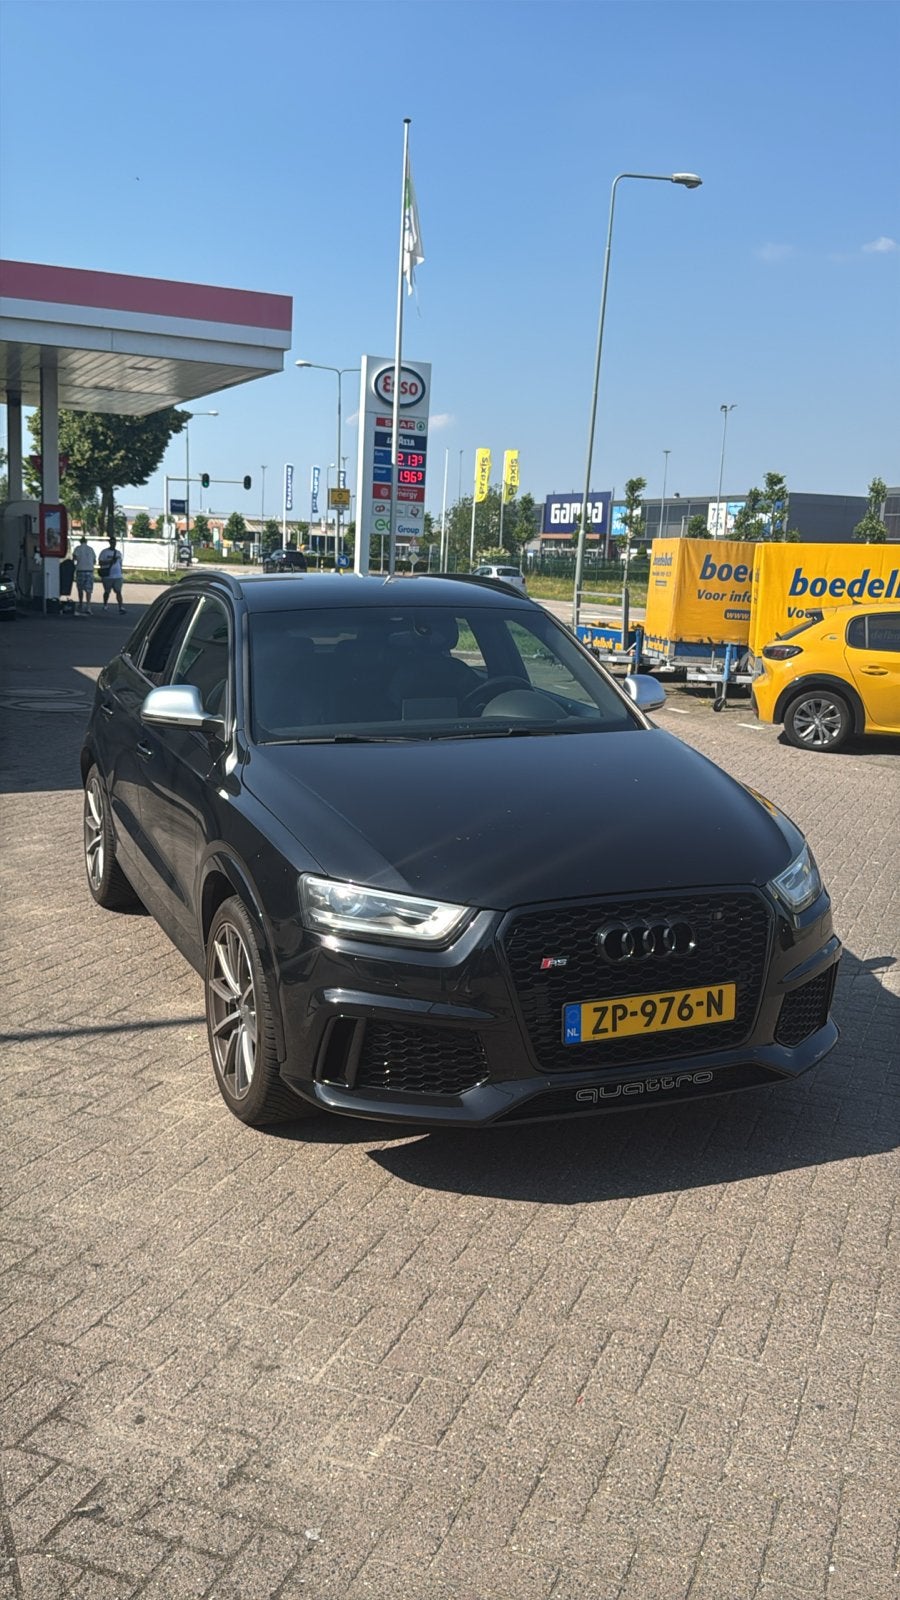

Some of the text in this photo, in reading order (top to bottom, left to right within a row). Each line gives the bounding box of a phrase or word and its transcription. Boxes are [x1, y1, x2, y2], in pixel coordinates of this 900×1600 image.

[383, 375, 418, 395] Eso
[384, 420, 415, 429] SAR
[397, 490, 418, 500] nergy
[397, 525, 420, 534] Group
[699, 553, 753, 583] boe
[697, 589, 726, 601] Voor
[592, 989, 723, 1035] ZP-976-N
[567, 1028, 579, 1037] NL
[575, 1071, 713, 1104] quattro
